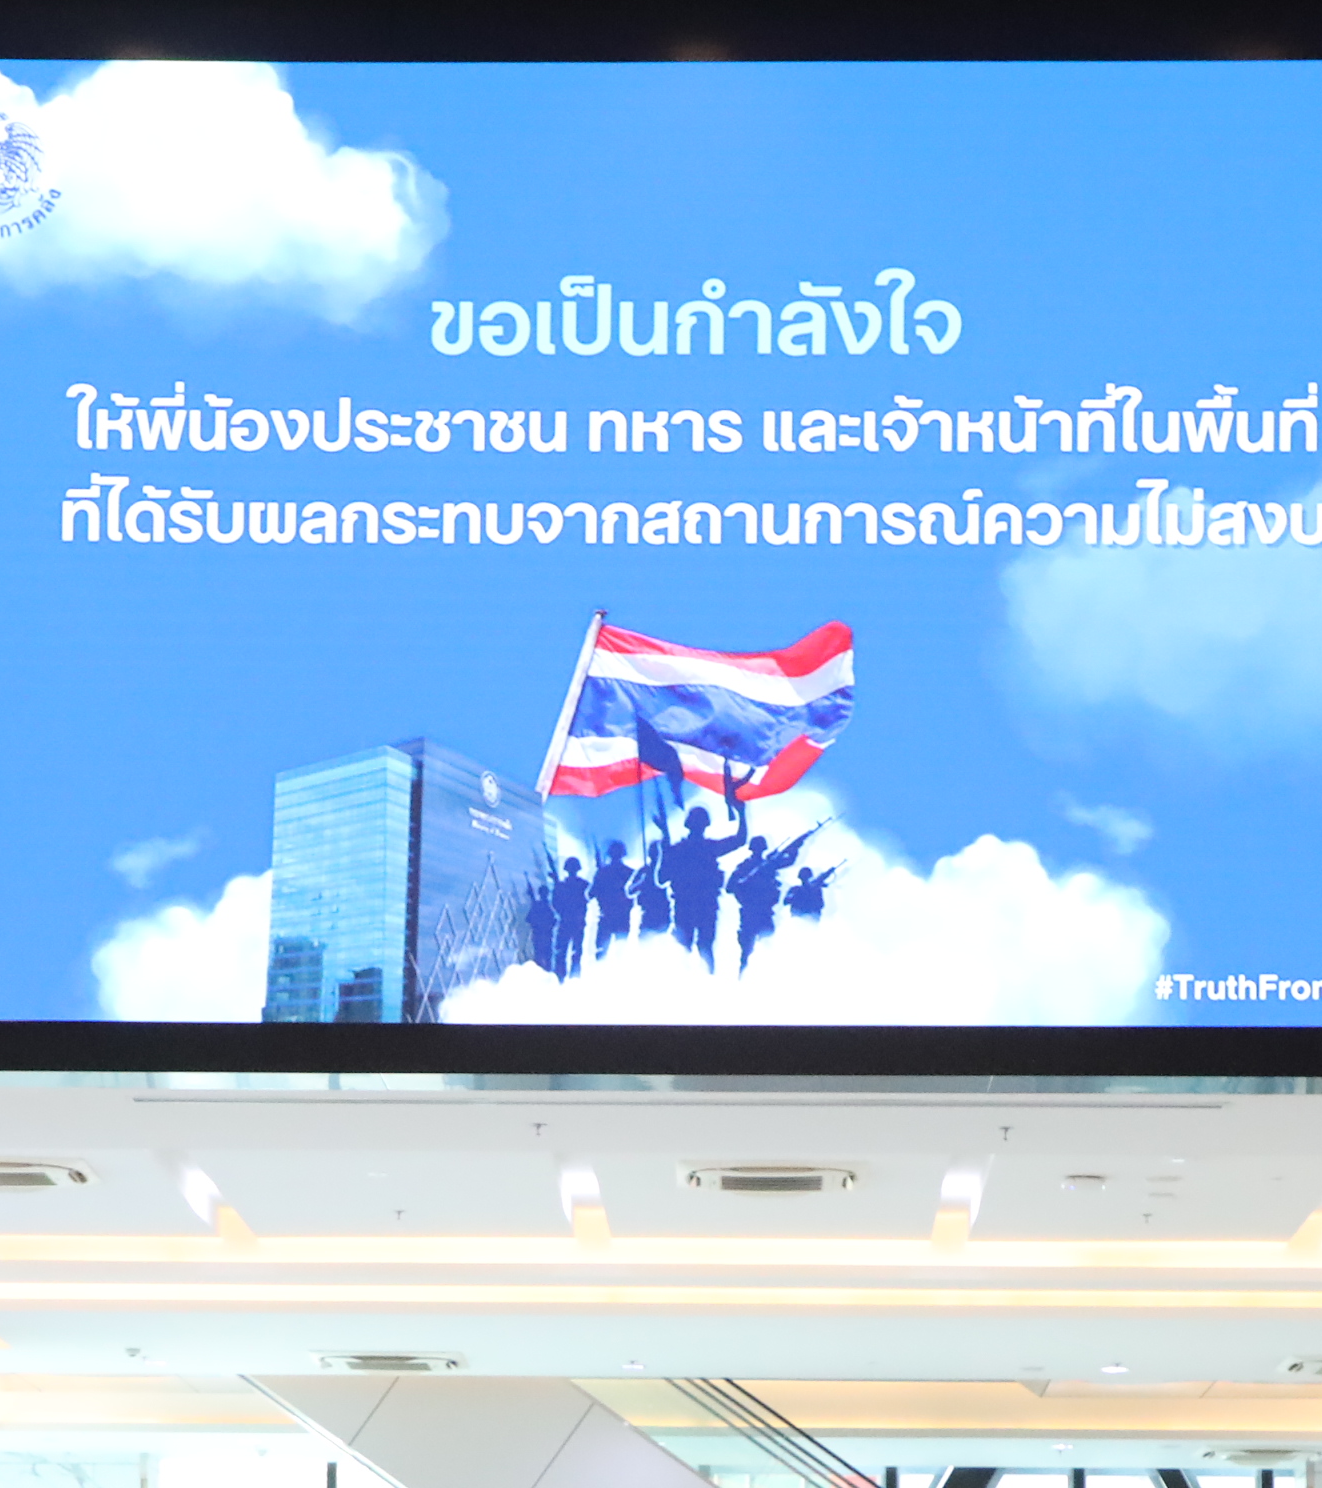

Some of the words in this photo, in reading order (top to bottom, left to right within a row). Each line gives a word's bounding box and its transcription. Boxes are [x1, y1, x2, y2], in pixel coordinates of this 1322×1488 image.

[430, 268, 963, 357] ขอเป็นกำลังใจ
[66, 381, 567, 453] ให้พี่น้องประชาชน
[588, 405, 743, 454] ทหาร
[762, 382, 1320, 454] และเจ้าหน้าที่ในพื้นที่
